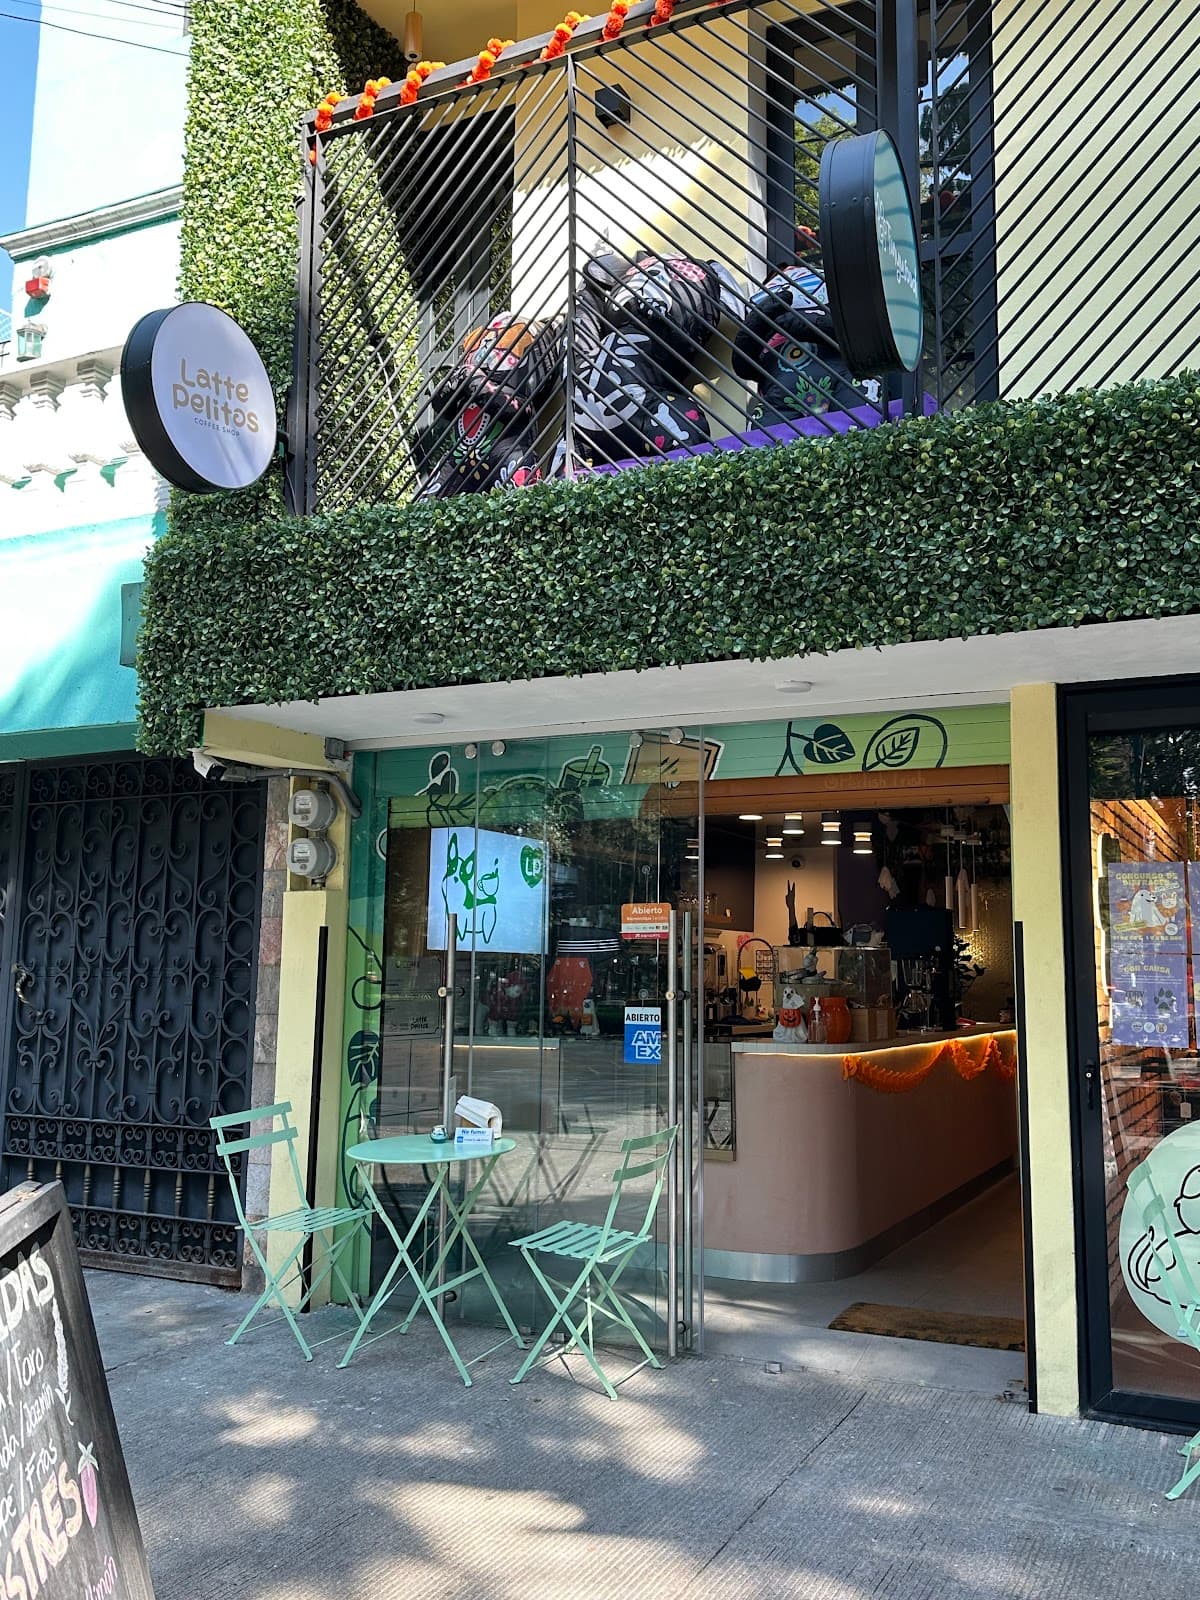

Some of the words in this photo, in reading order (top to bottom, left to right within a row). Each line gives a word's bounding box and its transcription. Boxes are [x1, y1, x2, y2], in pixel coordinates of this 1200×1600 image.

[181, 357, 249, 403] Latte
[193, 417, 220, 432] COFFEE
[222, 426, 240, 437] SHOP
[631, 905, 662, 914] Abierto
[625, 1013, 660, 1022] ABIERTO
[631, 1030, 661, 1046] AM
[635, 1044, 661, 1060] EX
[0, 1459, 82, 1600] STRES
